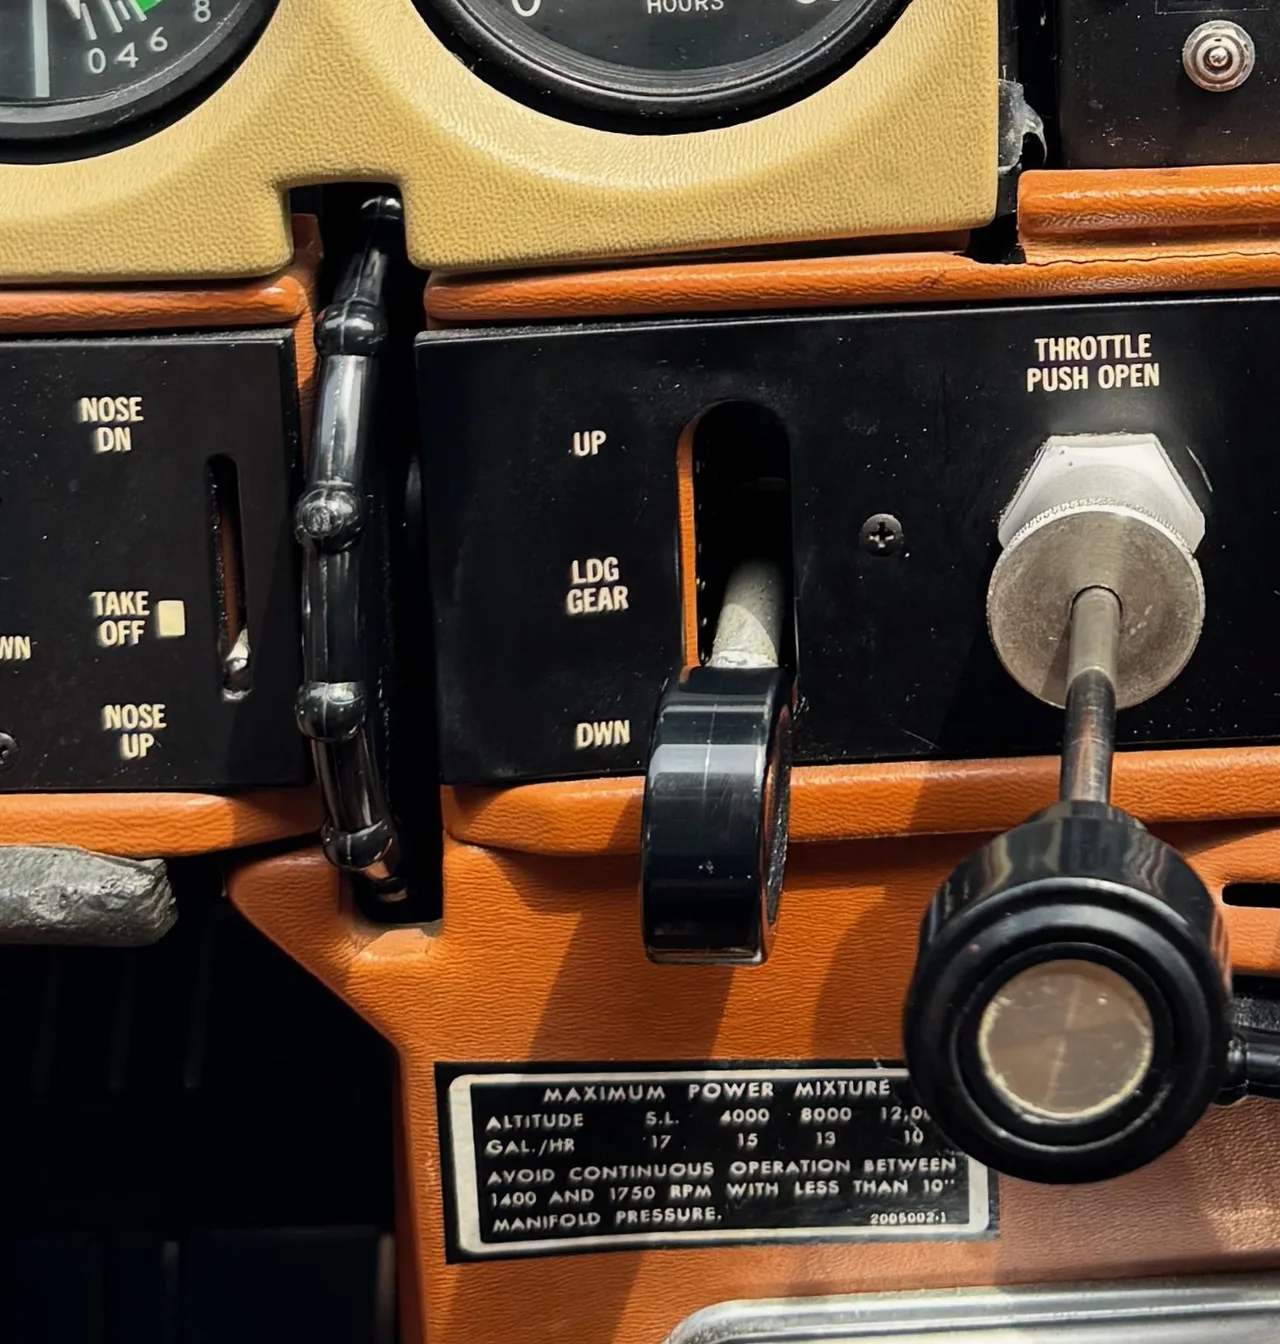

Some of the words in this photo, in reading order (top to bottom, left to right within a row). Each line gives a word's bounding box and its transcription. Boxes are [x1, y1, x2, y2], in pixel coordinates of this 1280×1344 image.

[1034, 334, 1152, 362] THROTTLE
[1026, 365, 1092, 393] PUSH
[1098, 364, 1160, 389] OPEN
[80, 398, 144, 422] NOSE
[96, 427, 131, 452] DN
[573, 431, 606, 455] UP
[571, 558, 620, 584] LDG
[92, 590, 150, 616] TAKE
[566, 586, 628, 613] GEAR
[100, 620, 144, 646] OFF
[104, 703, 166, 730] NOSE
[122, 733, 154, 759] UP
[576, 720, 630, 746] DWN
[543, 1084, 666, 1102] MAXIMUM
[688, 1082, 774, 1099] POWER
[794, 1080, 890, 1098] MIXTURE
[486, 1168, 554, 1187] AVOID
[568, 1162, 714, 1182] CONTINUOUS
[730, 1158, 851, 1176] OPERATION
[864, 1155, 956, 1174] BETWEEN
[492, 1212, 601, 1233] MANIFOLD
[616, 1206, 722, 1225] PRESSURE.
